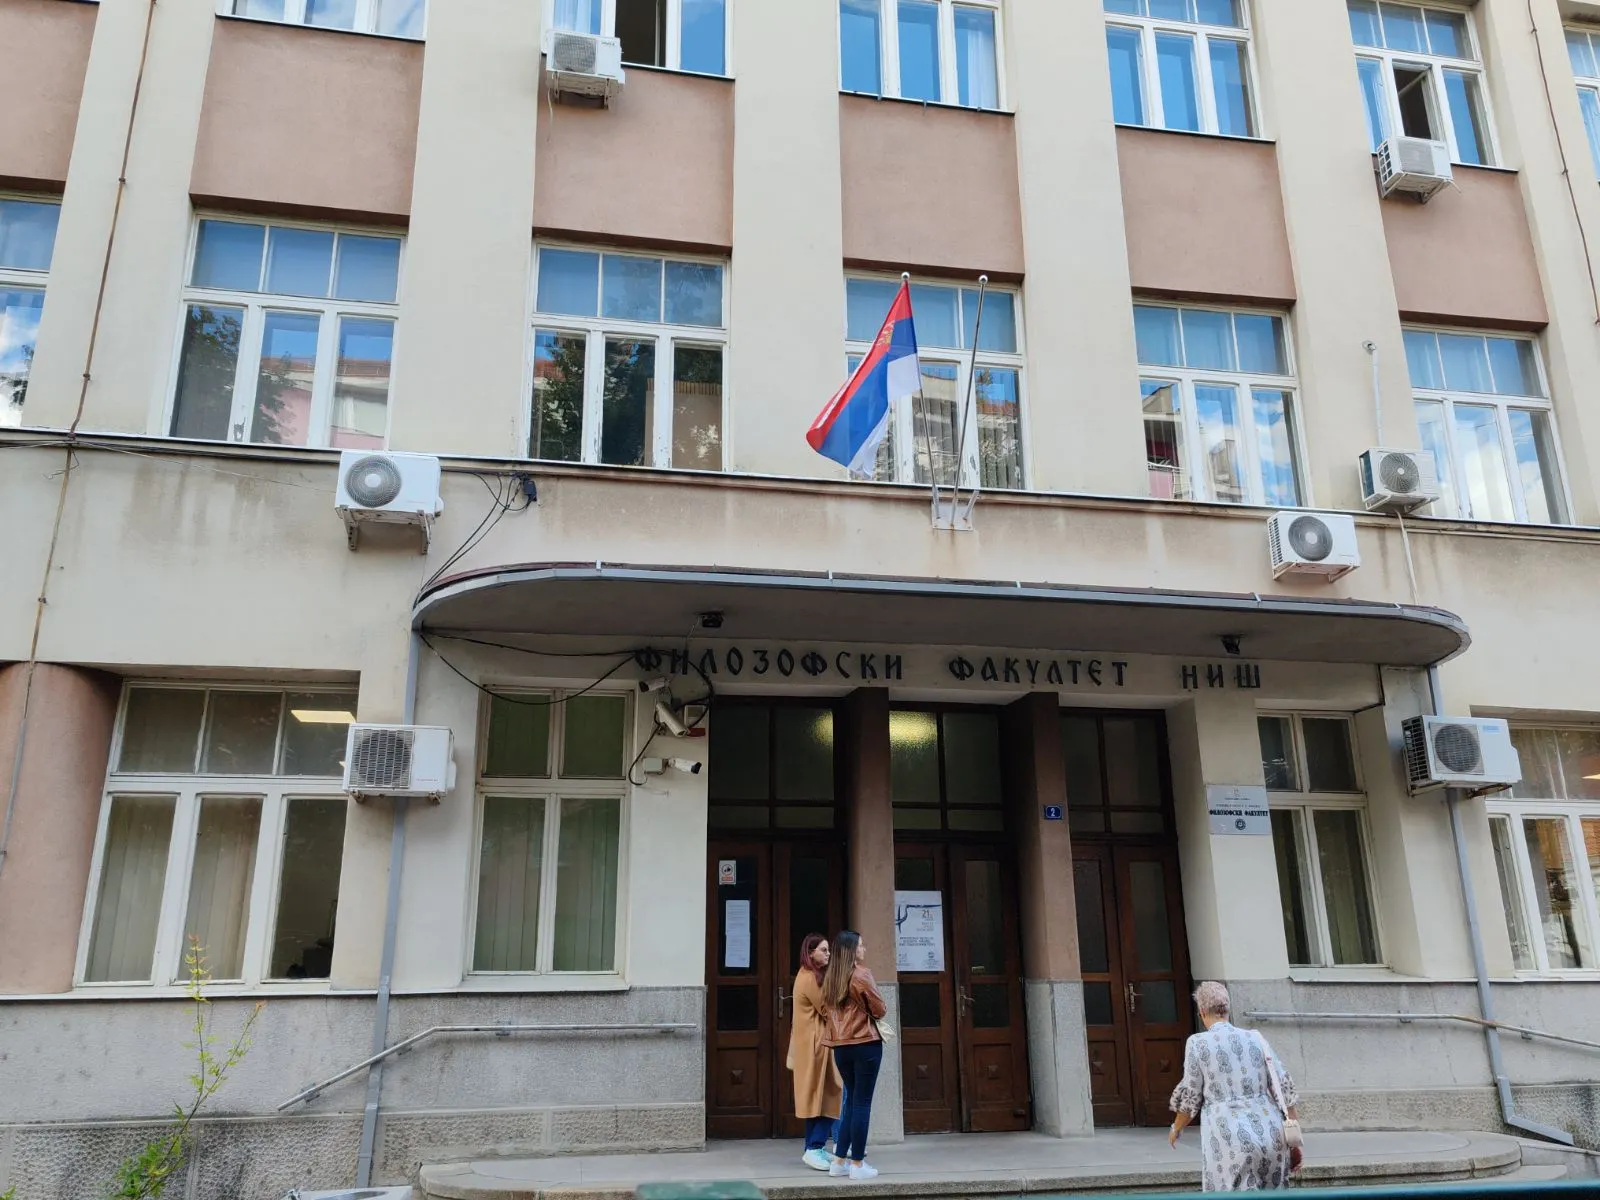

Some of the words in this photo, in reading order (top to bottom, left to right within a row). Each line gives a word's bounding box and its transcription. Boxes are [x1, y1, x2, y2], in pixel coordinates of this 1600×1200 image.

[634, 645, 902, 680] ФИЛОЗОФСКИ
[949, 656, 1128, 687] ФАКУЛТЕТ
[1181, 662, 1261, 690] НИШ
[1050, 808, 1056, 816] 2
